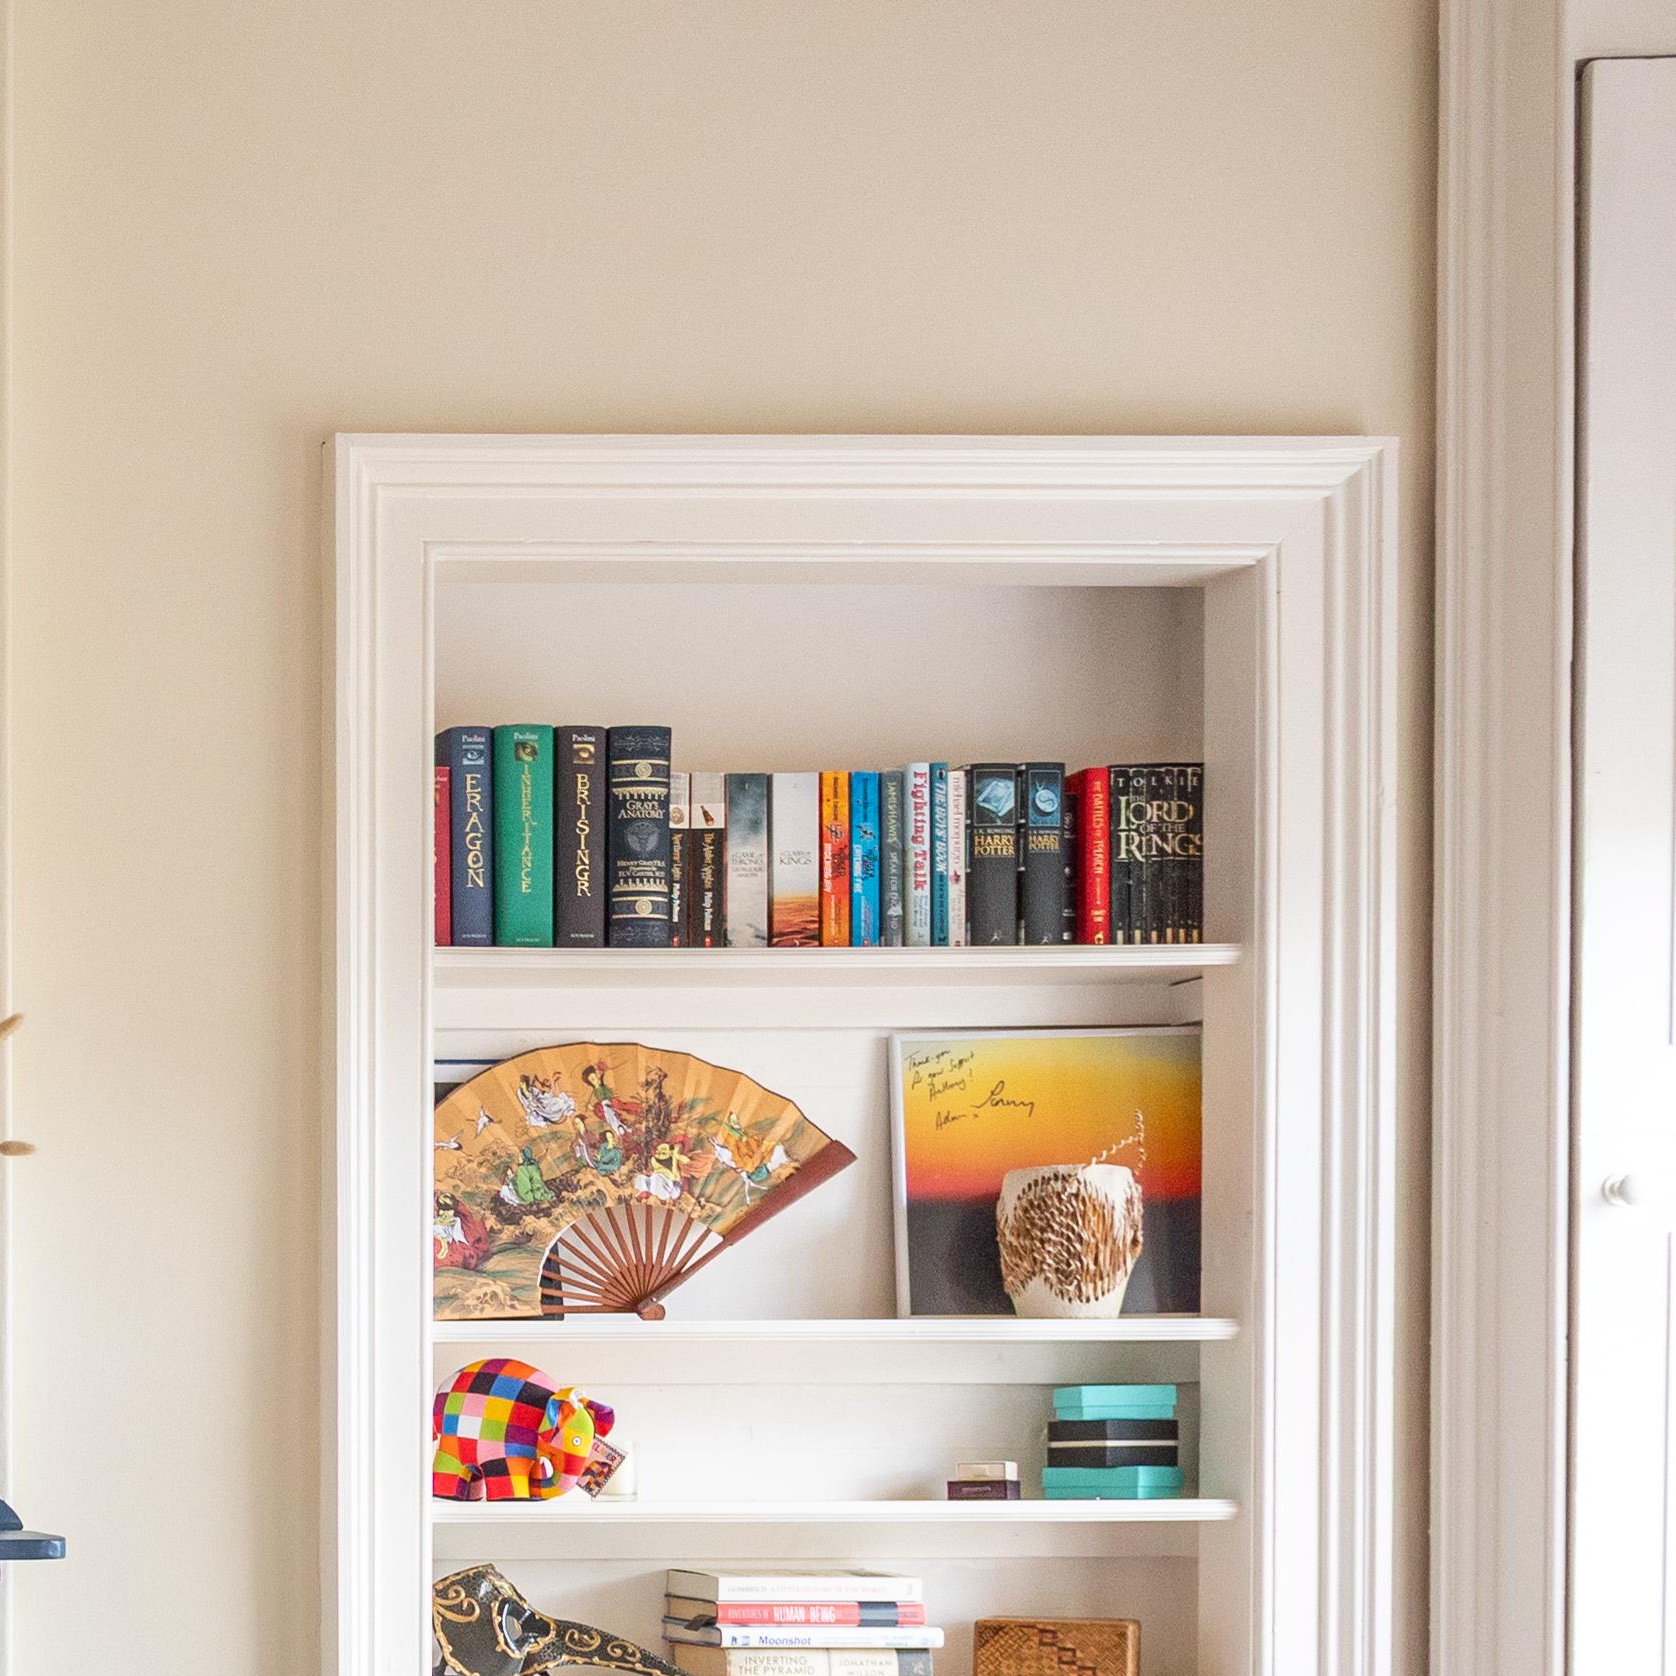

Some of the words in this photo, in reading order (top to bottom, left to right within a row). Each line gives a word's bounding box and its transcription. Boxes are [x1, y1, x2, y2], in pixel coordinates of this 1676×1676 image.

[935, 782, 946, 806] THE
[911, 771, 927, 846] Fighting
[1118, 796, 1194, 830] LORD
[617, 809, 666, 820] ANATOMY
[465, 774, 485, 888] ERAGON
[521, 764, 537, 893] INHERITANCE
[575, 773, 591, 897] BRISINGR
[974, 834, 1014, 846] HARRY
[1029, 835, 1059, 844] HARRY
[974, 845, 1015, 856] POTTER
[1029, 843, 1059, 851] POTTER
[1117, 831, 1202, 863] RINGS
[779, 857, 812, 866] KINGS
[913, 850, 927, 891] Talk
[773, 1606, 806, 1622] HUMAN
[810, 1606, 836, 1623] BEING
[758, 1635, 811, 1646] Moonshot
[744, 1655, 808, 1666] INVERTING
[839, 1659, 892, 1667] JONATHAN
[738, 1666, 761, 1675] THE
[763, 1666, 815, 1676] PYRAMID
[847, 1669, 885, 1676] WILSON
